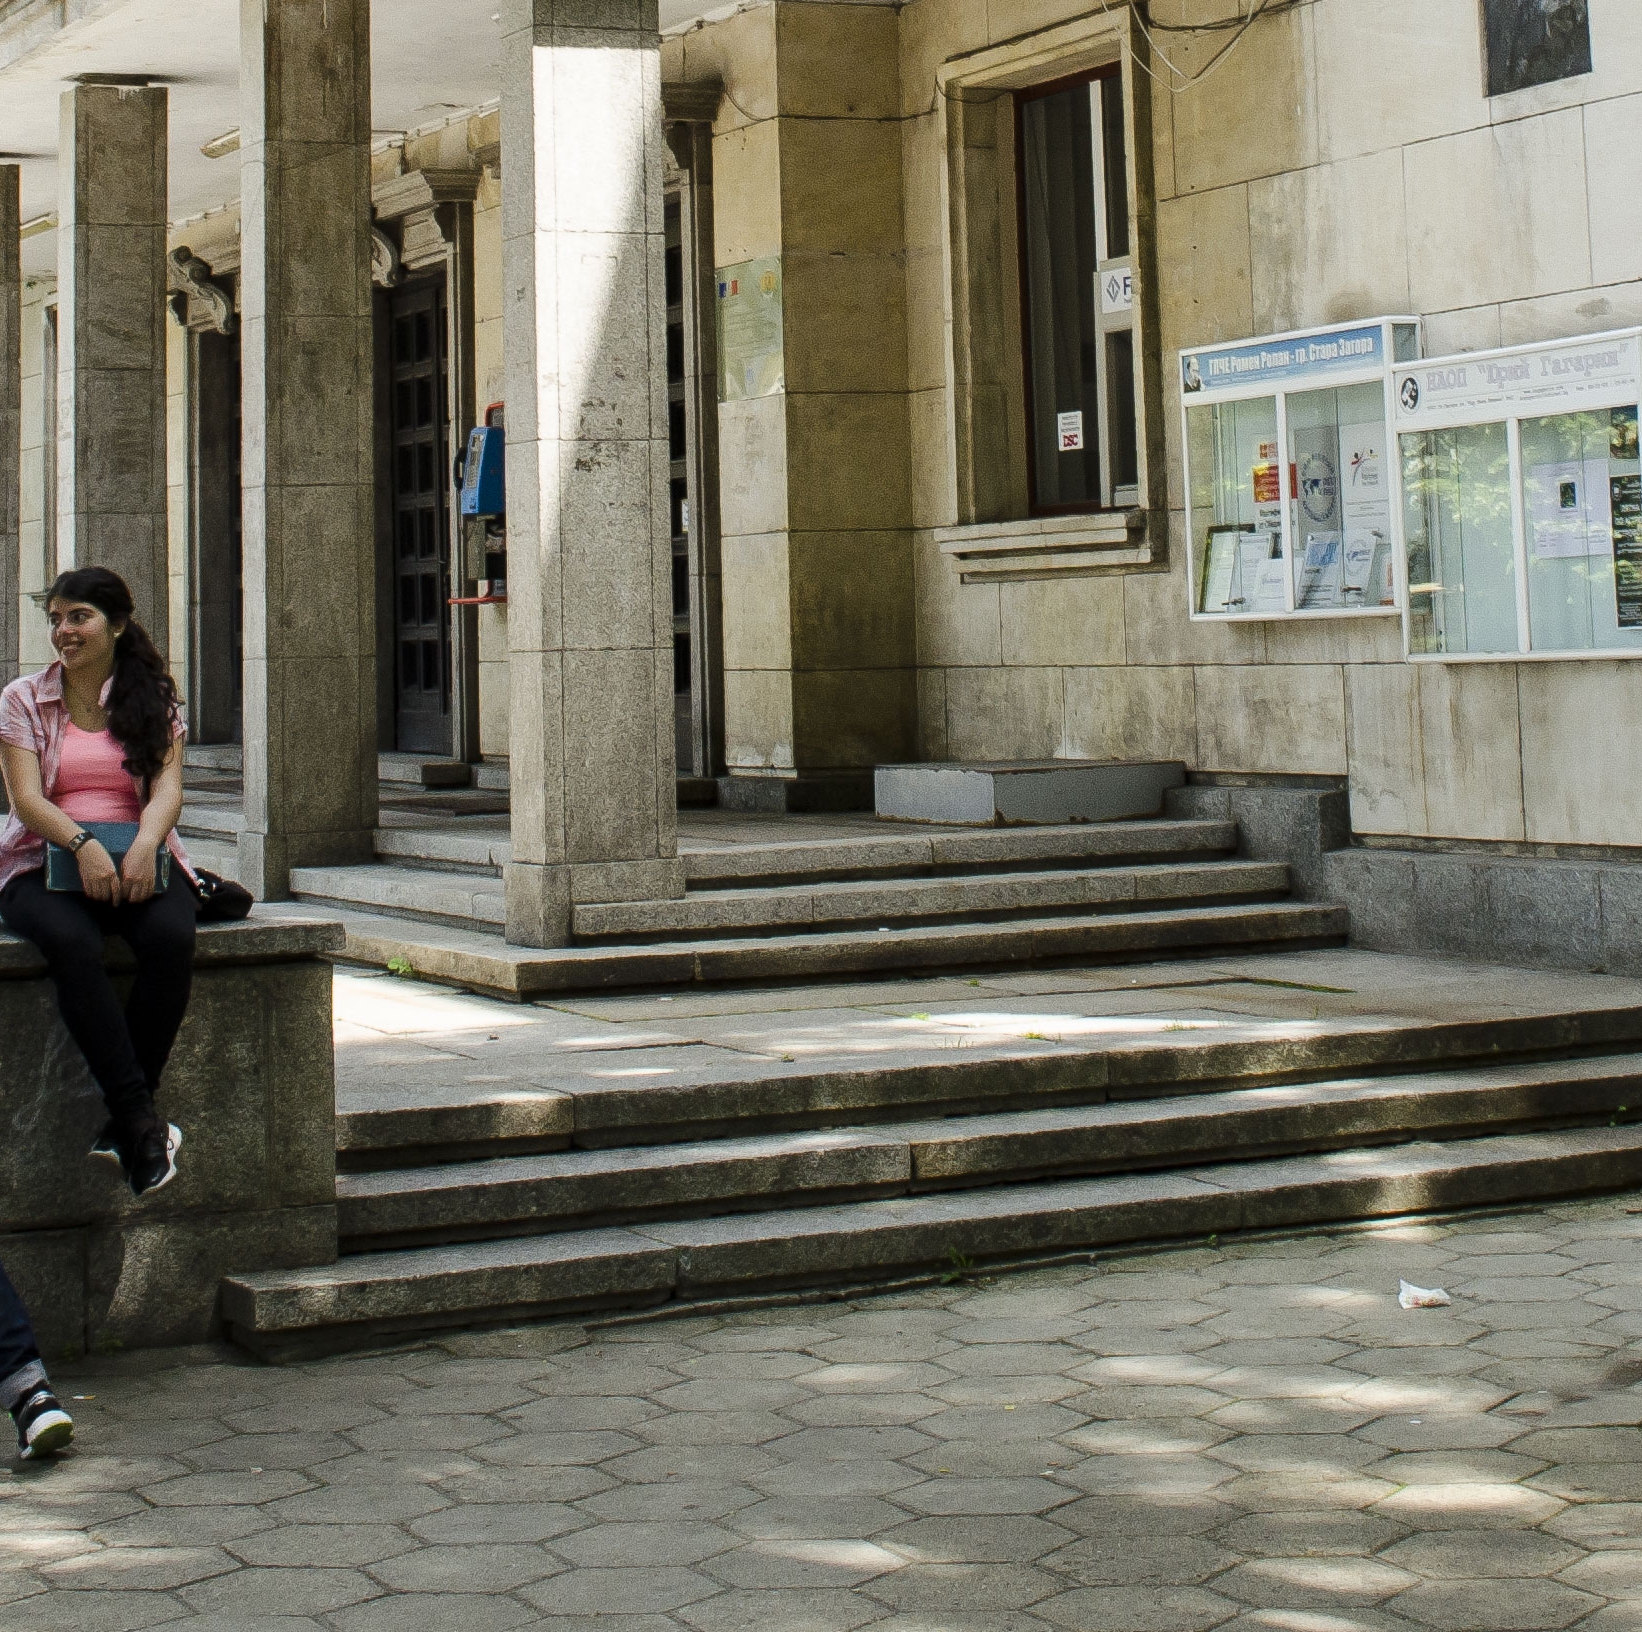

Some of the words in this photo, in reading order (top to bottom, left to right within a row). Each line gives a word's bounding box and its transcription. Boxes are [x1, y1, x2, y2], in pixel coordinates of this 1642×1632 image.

[1231, 354, 1260, 374] Ромен
[1260, 350, 1290, 369] Ролан
[1309, 342, 1338, 362] Стара
[1339, 336, 1374, 357] Загора
